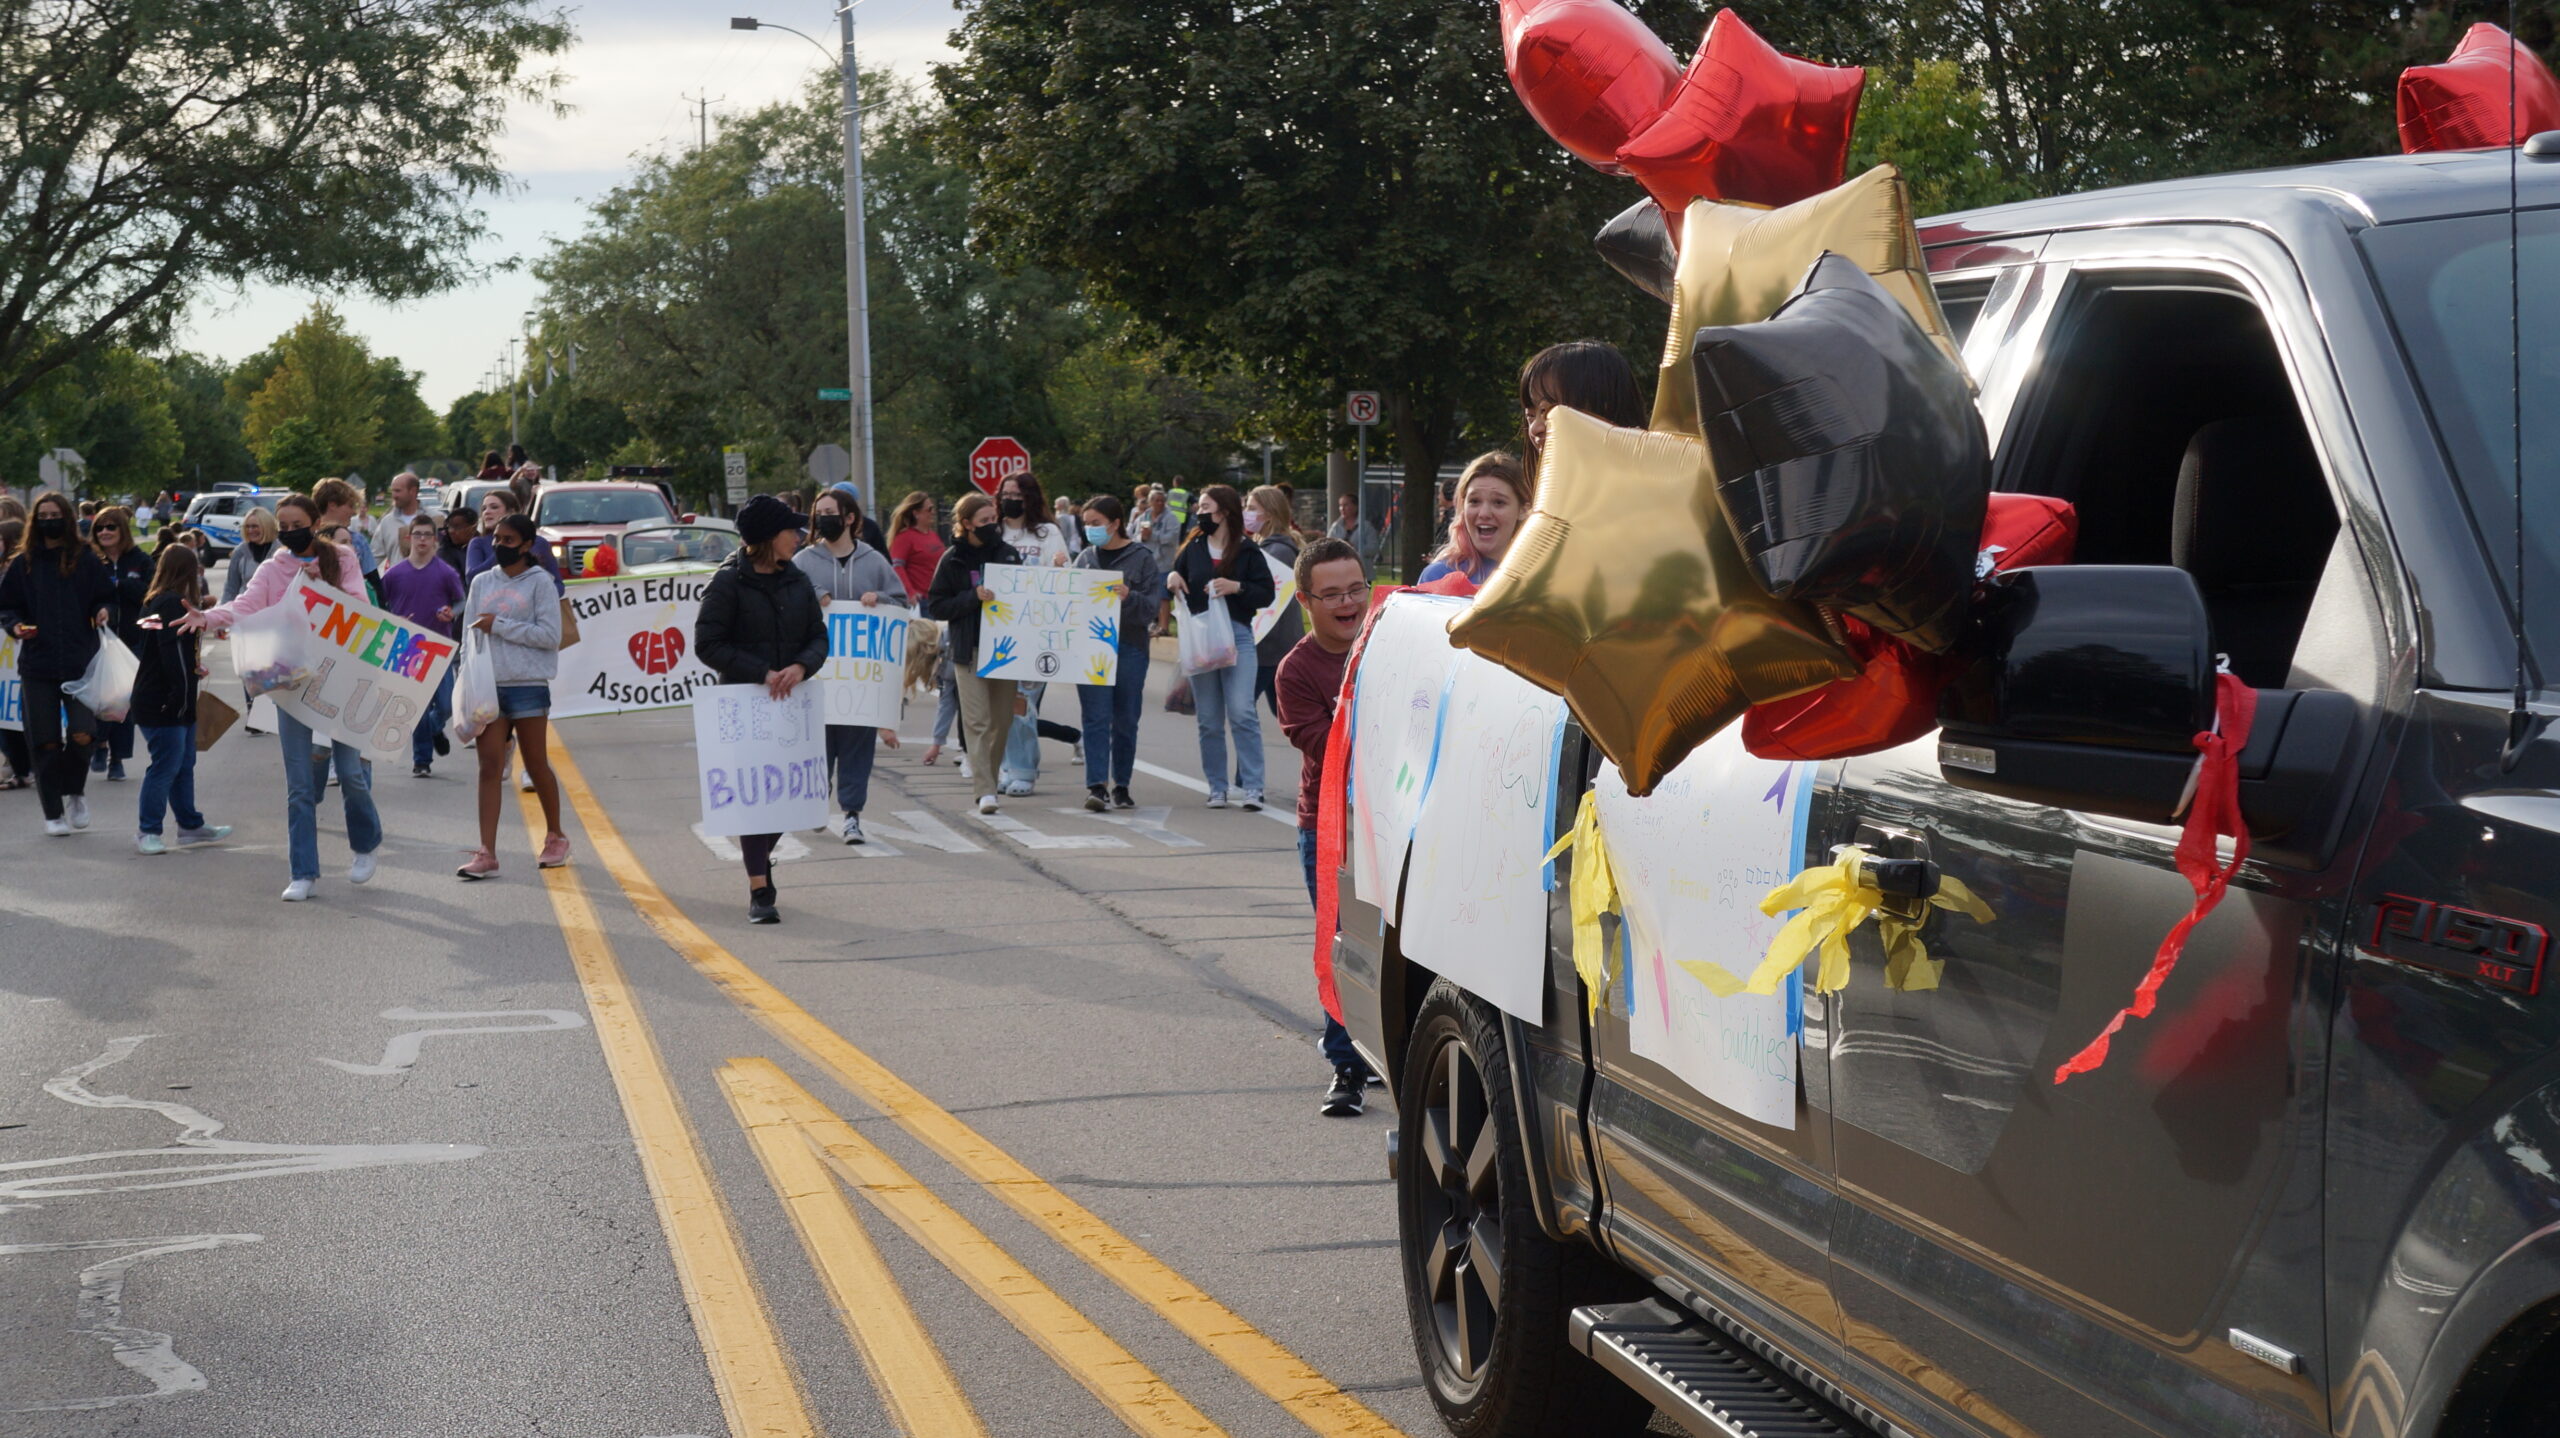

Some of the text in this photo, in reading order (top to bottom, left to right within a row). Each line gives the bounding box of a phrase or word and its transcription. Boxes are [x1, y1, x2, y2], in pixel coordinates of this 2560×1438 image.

[727, 465, 745, 476] 20
[975, 456, 1026, 479] STOP
[999, 567, 1084, 596] SERVICE
[572, 577, 705, 620] tavia Educ
[1018, 599, 1083, 627] ABOVE
[628, 626, 686, 676] BEA
[1038, 628, 1077, 651] SELF
[587, 670, 718, 705] Associatio
[825, 684, 881, 718] 021
[301, 656, 418, 752] LUB
[706, 756, 828, 811] BUDDIES
[2477, 960, 2517, 982] XLT
